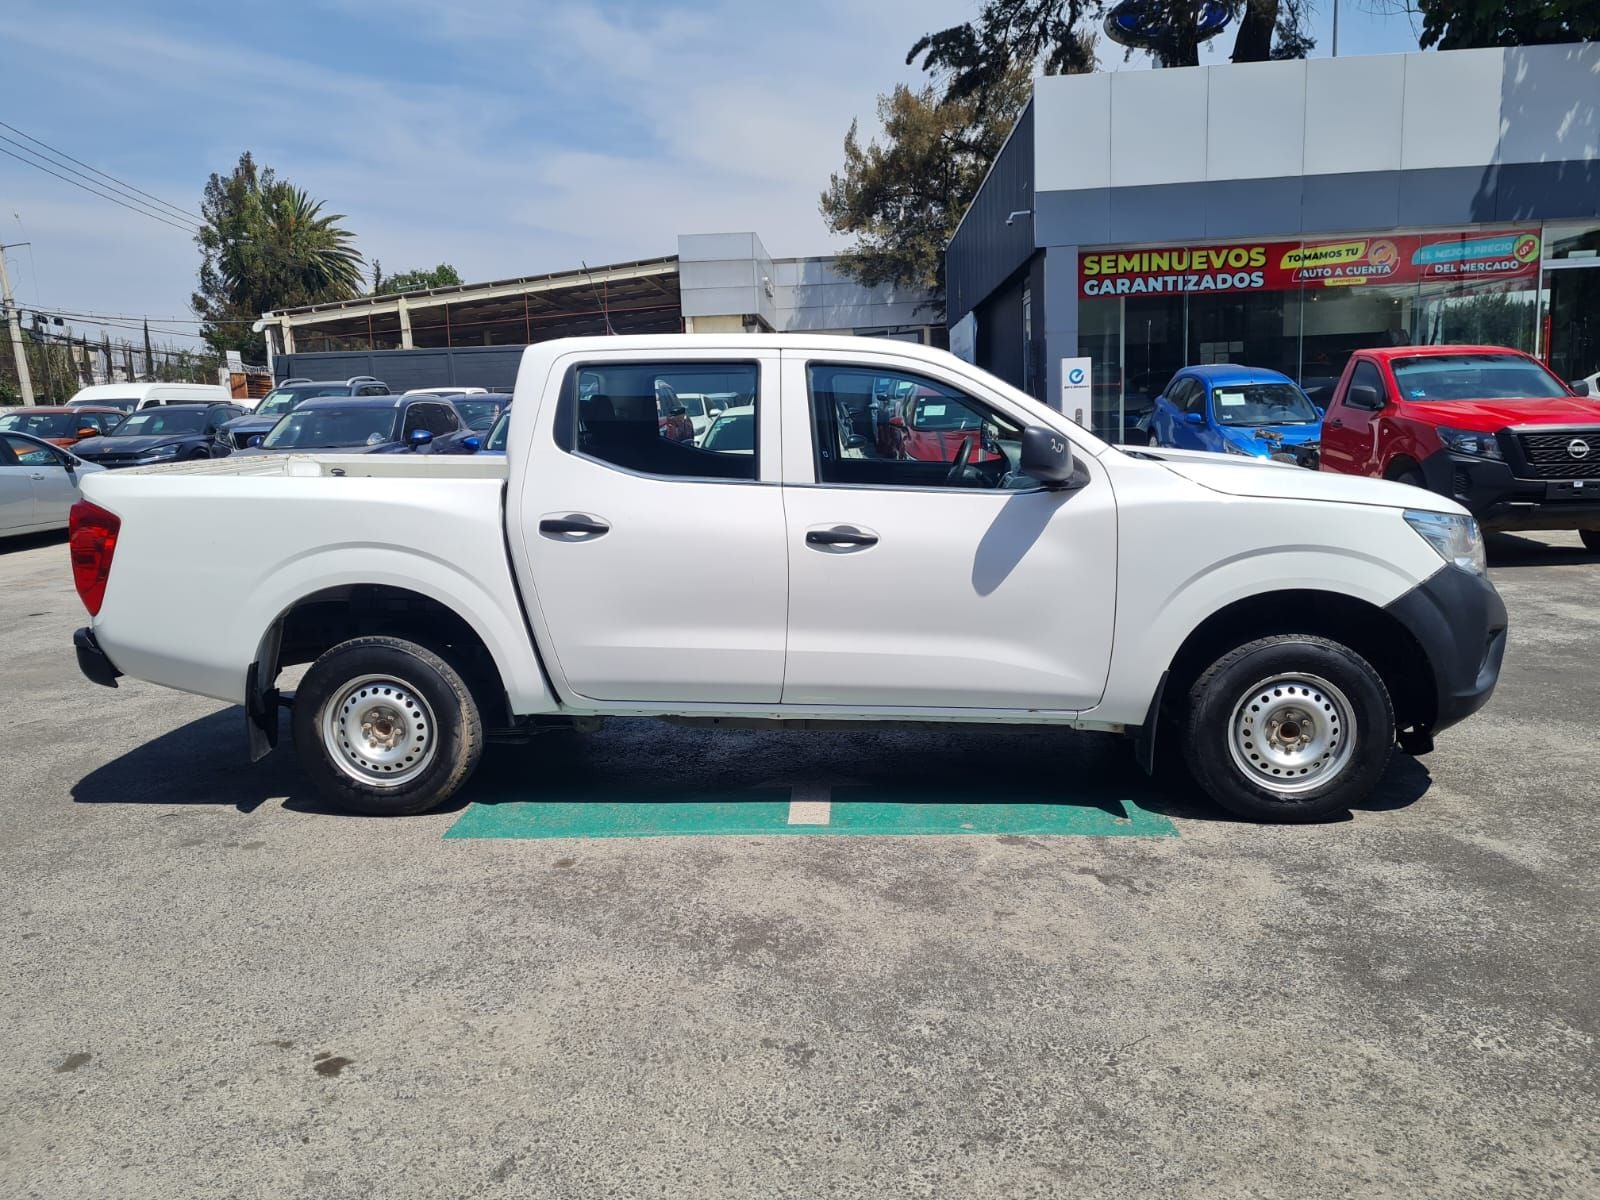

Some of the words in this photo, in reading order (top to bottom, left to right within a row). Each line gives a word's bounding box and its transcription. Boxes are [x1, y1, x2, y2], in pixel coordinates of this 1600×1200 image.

[1287, 249, 1342, 263] TOMAMOS
[1345, 247, 1359, 257] TU
[1473, 242, 1513, 255] PRECIO
[1083, 247, 1266, 276] SEMINUEVOS
[1434, 264, 1457, 273] DEL
[1460, 260, 1519, 272] MERCADO
[1299, 267, 1332, 278] AUTO
[1334, 267, 1343, 276] A
[1346, 264, 1391, 276] CUENTA
[1083, 271, 1265, 296] GARANTIZADOS
